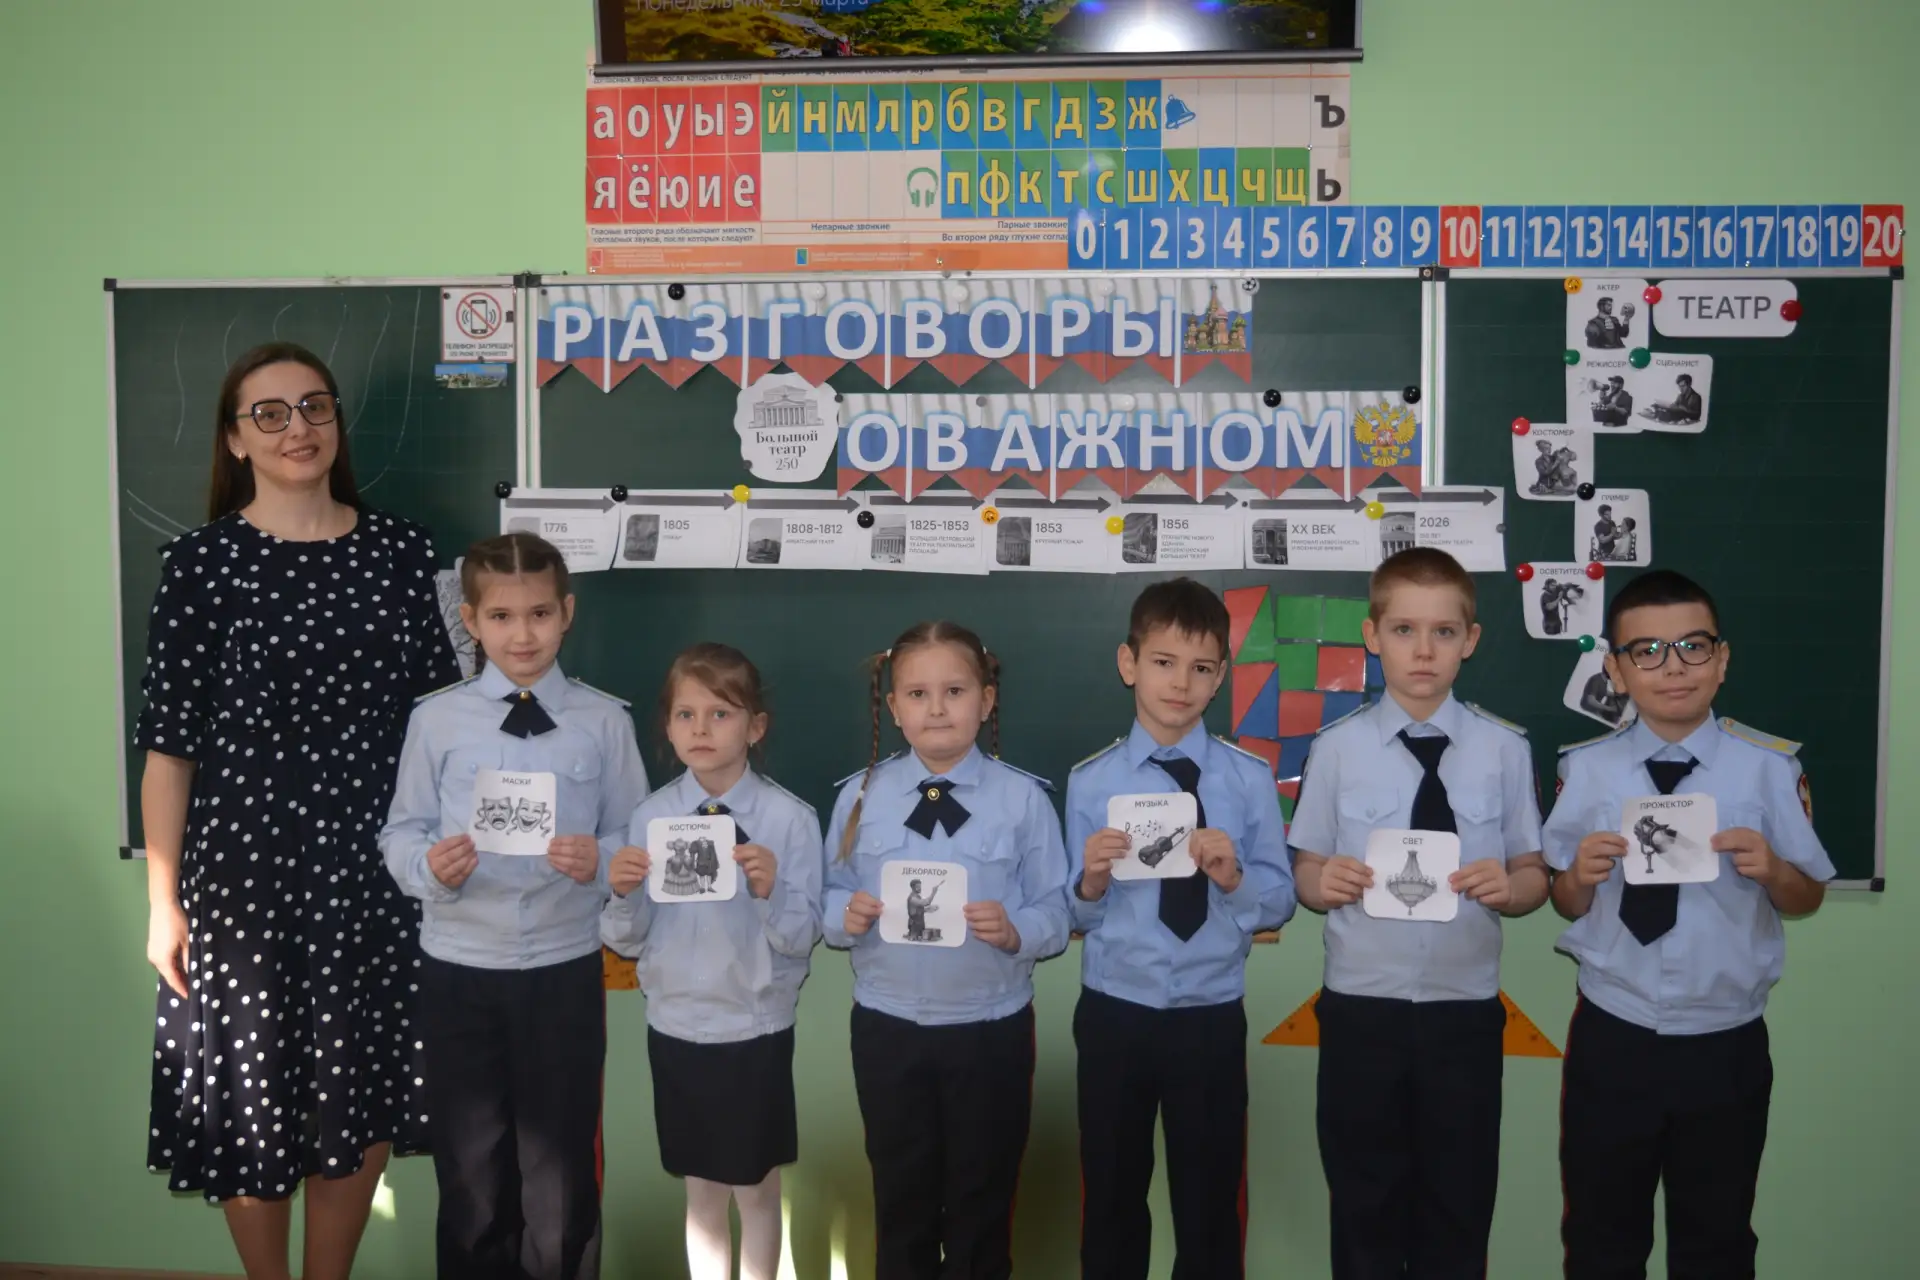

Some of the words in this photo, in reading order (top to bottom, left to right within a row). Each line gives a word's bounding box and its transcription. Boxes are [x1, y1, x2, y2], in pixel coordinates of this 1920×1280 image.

[768, 89, 790, 134] й
[803, 101, 827, 133] н
[836, 100, 867, 133] м
[875, 100, 899, 133] л
[911, 98, 934, 145] р
[946, 86, 971, 133] б
[983, 98, 1008, 131] в
[1023, 98, 1042, 131] г
[1054, 97, 1084, 139] д
[1095, 96, 1117, 130] з
[1127, 96, 1159, 130] ж
[594, 105, 615, 139] а
[628, 104, 650, 138] о
[663, 104, 685, 149] у
[695, 103, 724, 136] ы
[734, 102, 755, 136] э
[594, 176, 617, 209] я
[629, 163, 651, 209] ё
[659, 175, 690, 209] ю
[697, 175, 721, 208] и
[734, 174, 755, 208] е
[946, 171, 970, 204] п
[979, 159, 1011, 217] ф
[1019, 170, 1042, 204] к
[1057, 170, 1081, 204] т
[1096, 170, 1115, 204] с
[1127, 170, 1158, 203] ш
[1167, 169, 1191, 203] х
[1203, 168, 1229, 208] ц
[1242, 168, 1266, 202] ч
[1275, 168, 1307, 207] щ
[997, 221, 1031, 231] Парные
[942, 232, 955, 241] Во
[1075, 217, 1097, 260] 0
[1113, 217, 1130, 260] 1
[1149, 217, 1170, 260] 2
[1186, 217, 1206, 260] 3
[1222, 217, 1245, 260] 4
[1260, 217, 1281, 260] 5
[1297, 217, 1319, 260] 6
[1336, 217, 1356, 260] 7
[1372, 217, 1394, 260] 8
[1409, 217, 1432, 260] 9
[1443, 217, 1478, 259] 10
[1484, 217, 1517, 259] 11
[1526, 217, 1562, 259] 12
[1568, 217, 1605, 259] 13
[1612, 217, 1649, 259] 14
[1655, 215, 1691, 258] 15
[1696, 215, 1734, 258] 16
[1739, 215, 1775, 258] 17
[1781, 215, 1818, 258] 18
[1823, 215, 1859, 258] 19
[1863, 215, 1903, 258] 20
[1678, 296, 1772, 320] ТЕАТР
[552, 299, 1174, 363] РАЗГОВОРЫ
[1586, 360, 1627, 369] РЕЖИССЕР
[1656, 359, 1699, 368] СЦЕНАРИСТ
[756, 430, 818, 444] Большой
[1532, 429, 1575, 437] КОСТЮМЕР
[768, 445, 807, 458] театр
[776, 457, 799, 471] 250
[544, 522, 568, 534] 1776
[663, 519, 690, 531] 1805
[910, 519, 970, 532] 1825-1853
[1035, 522, 1063, 534] 1853
[1162, 518, 1189, 530] 1856
[1419, 516, 1450, 528] 2026
[786, 523, 843, 535] 1808-1812
[1312, 523, 1336, 535] ВЕК
[502, 776, 532, 785] МАСКИ
[1134, 799, 1169, 808] МУЗЫКА
[1639, 799, 1694, 811] ПРОЖЕКТОР
[668, 823, 711, 832] КОСТЮМЫ
[1402, 836, 1423, 846] СВЕТ
[901, 866, 948, 877] ДЕКОРАТОР
